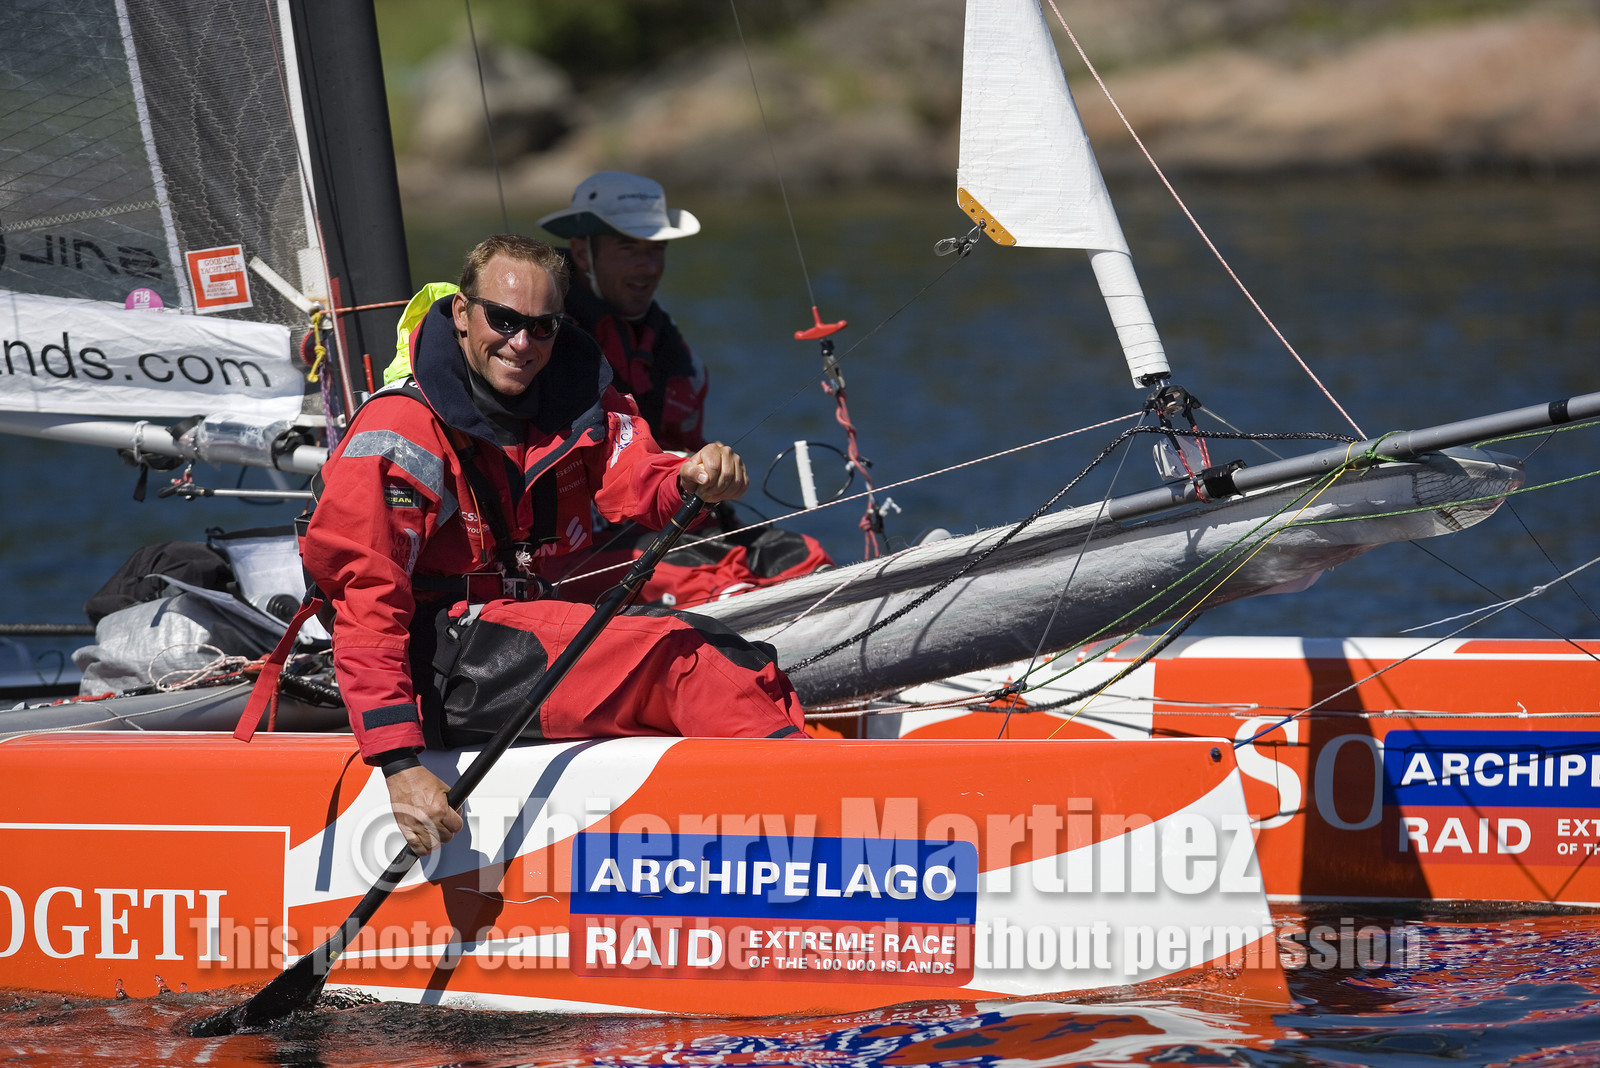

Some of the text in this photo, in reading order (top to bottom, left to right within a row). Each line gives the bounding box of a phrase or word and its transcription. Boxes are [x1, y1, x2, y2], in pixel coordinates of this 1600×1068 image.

[134, 290, 150, 303] F18
[0, 331, 271, 387] nds.com
[1400, 816, 1532, 854] RAID
[1557, 842, 1578, 855] OF
[590, 857, 957, 901] ARCHIPELAGO
[585, 926, 723, 967] RAID
[749, 930, 956, 955] EXTREME RACE
[749, 956, 955, 975] OF THE 100 000 ISLANDS
